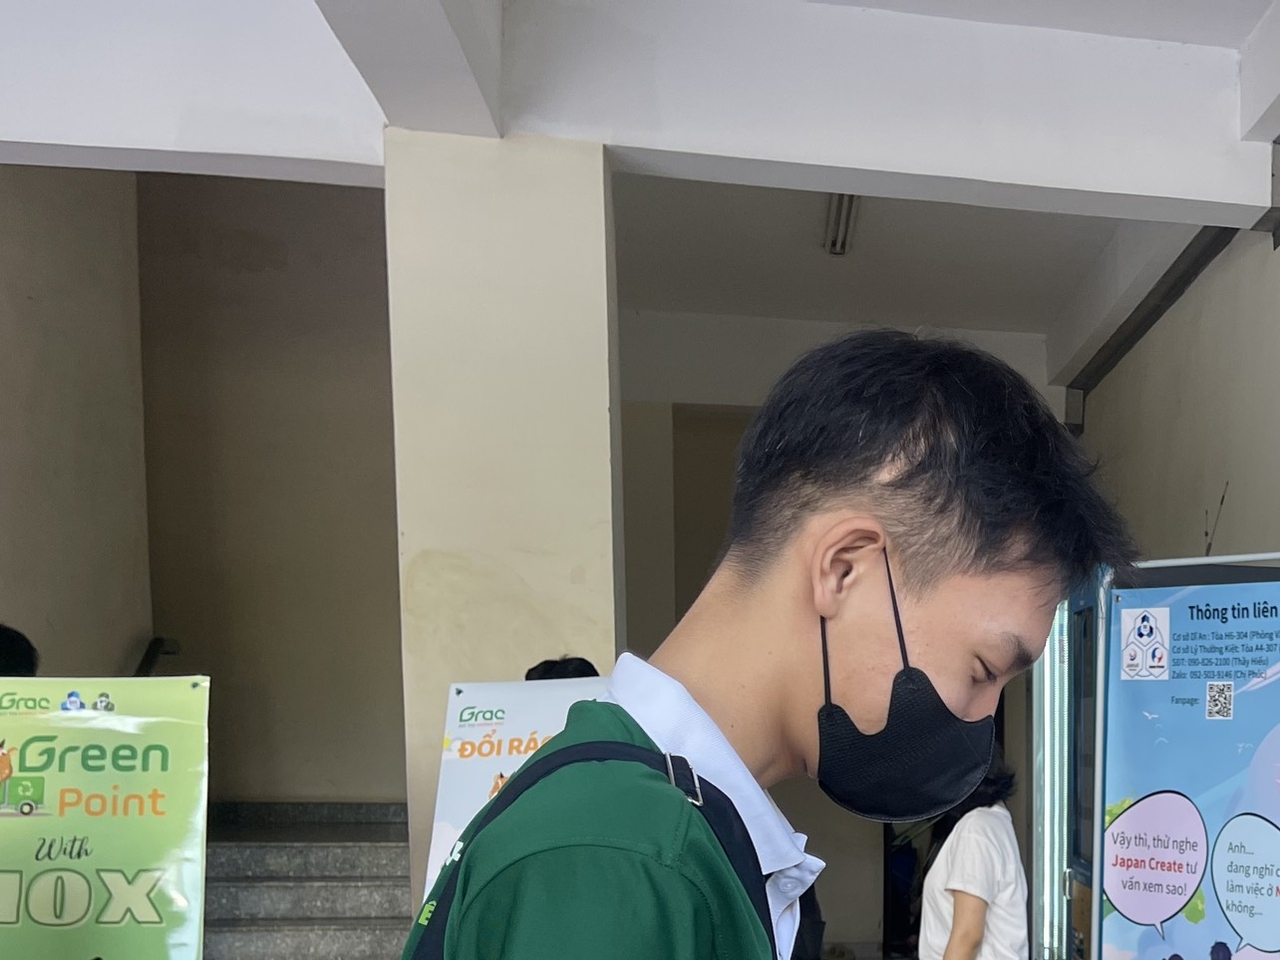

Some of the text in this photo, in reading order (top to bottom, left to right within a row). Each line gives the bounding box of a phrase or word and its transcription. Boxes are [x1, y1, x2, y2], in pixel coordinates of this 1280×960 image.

[1188, 603, 1228, 624] Thông
[1231, 602, 1250, 619] tin
[1253, 601, 1278, 618] liên
[459, 706, 505, 722] Grac
[18, 735, 169, 773] Green
[458, 729, 503, 759] ĐỔI
[58, 784, 167, 817] Point
[35, 836, 94, 861] With
[1111, 831, 1198, 855] Vậy thì, thử nghe
[1227, 841, 1254, 855] Anh...
[1111, 854, 1198, 875] Japan Create tư
[1227, 861, 1251, 878] đang
[1252, 863, 1275, 880] nghĩ
[1121, 875, 1187, 897] vấn xem sao!
[1226, 880, 1244, 894] làm
[1246, 882, 1265, 899] việc
[1266, 883, 1274, 897] ở
[1226, 899, 1263, 918] không...
